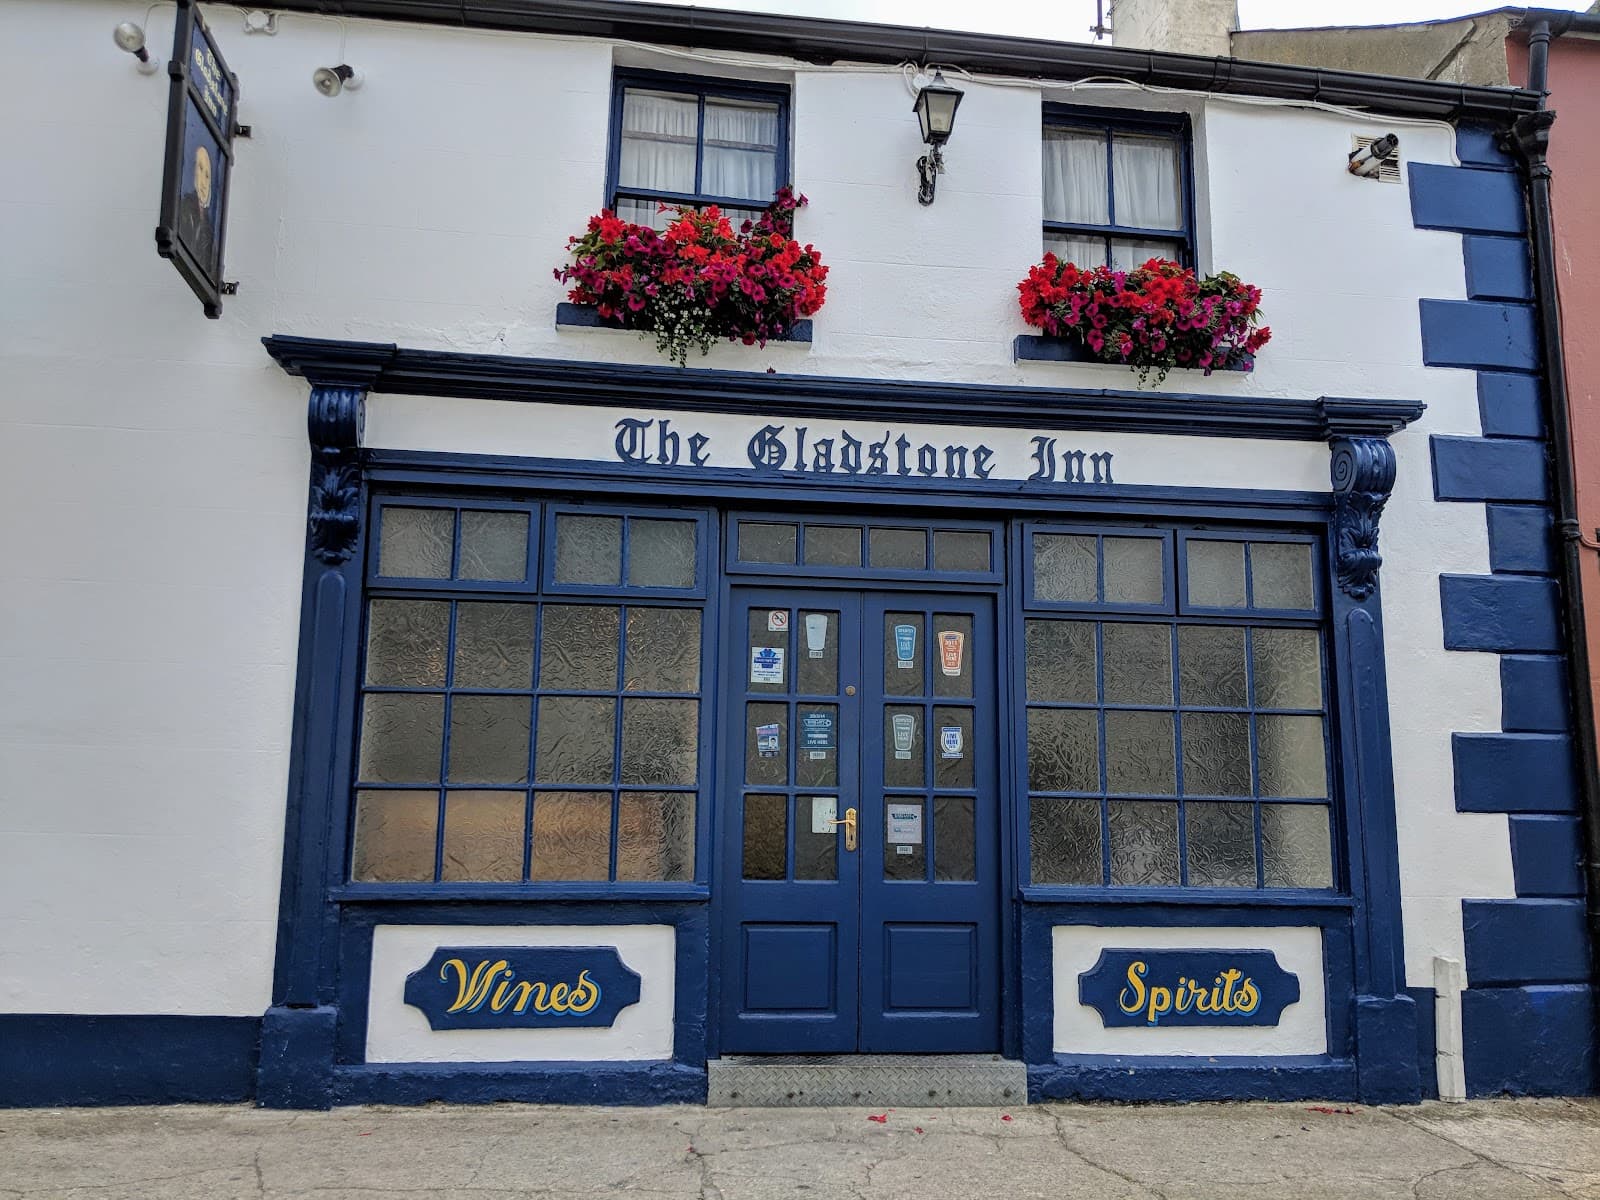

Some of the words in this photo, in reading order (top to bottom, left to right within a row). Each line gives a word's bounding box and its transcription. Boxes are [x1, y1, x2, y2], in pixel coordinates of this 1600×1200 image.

[207, 47, 221, 79] The
[614, 417, 711, 467] The
[746, 423, 996, 478] Gladstone
[1028, 435, 1115, 485] Inn
[440, 959, 602, 1016] Wines
[1118, 960, 1261, 1026] Spirits
